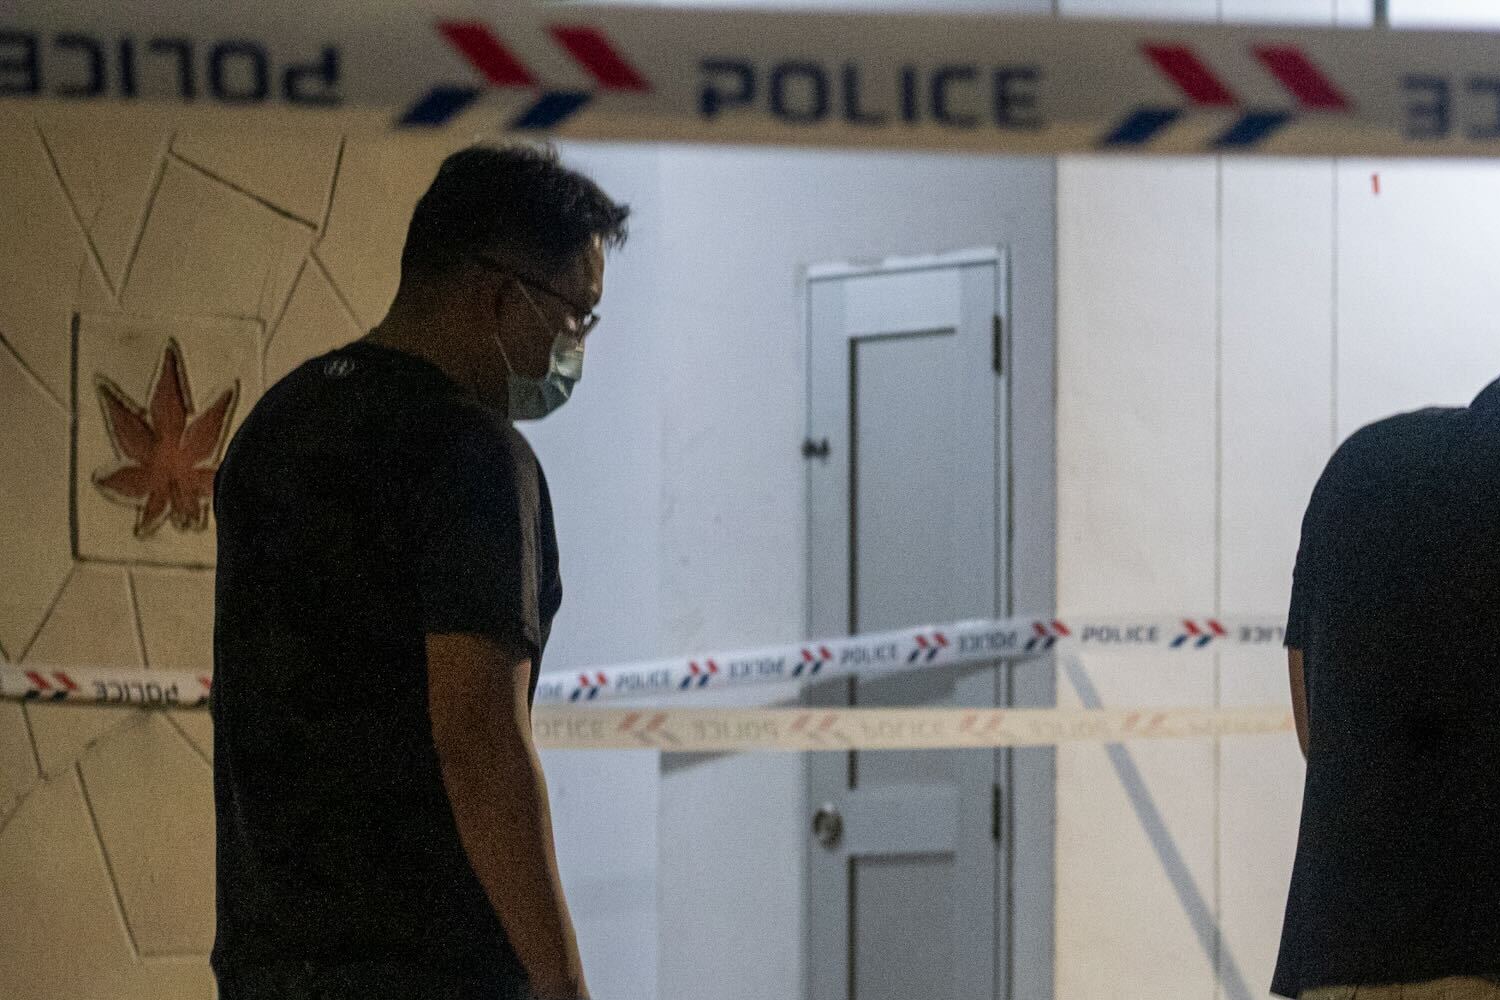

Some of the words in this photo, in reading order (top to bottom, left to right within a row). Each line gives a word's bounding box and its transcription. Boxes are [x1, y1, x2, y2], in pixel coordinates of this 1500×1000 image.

[0, 27, 343, 108] POLICE
[698, 56, 1046, 131] POLICE
[1081, 625, 1159, 643] POLICE
